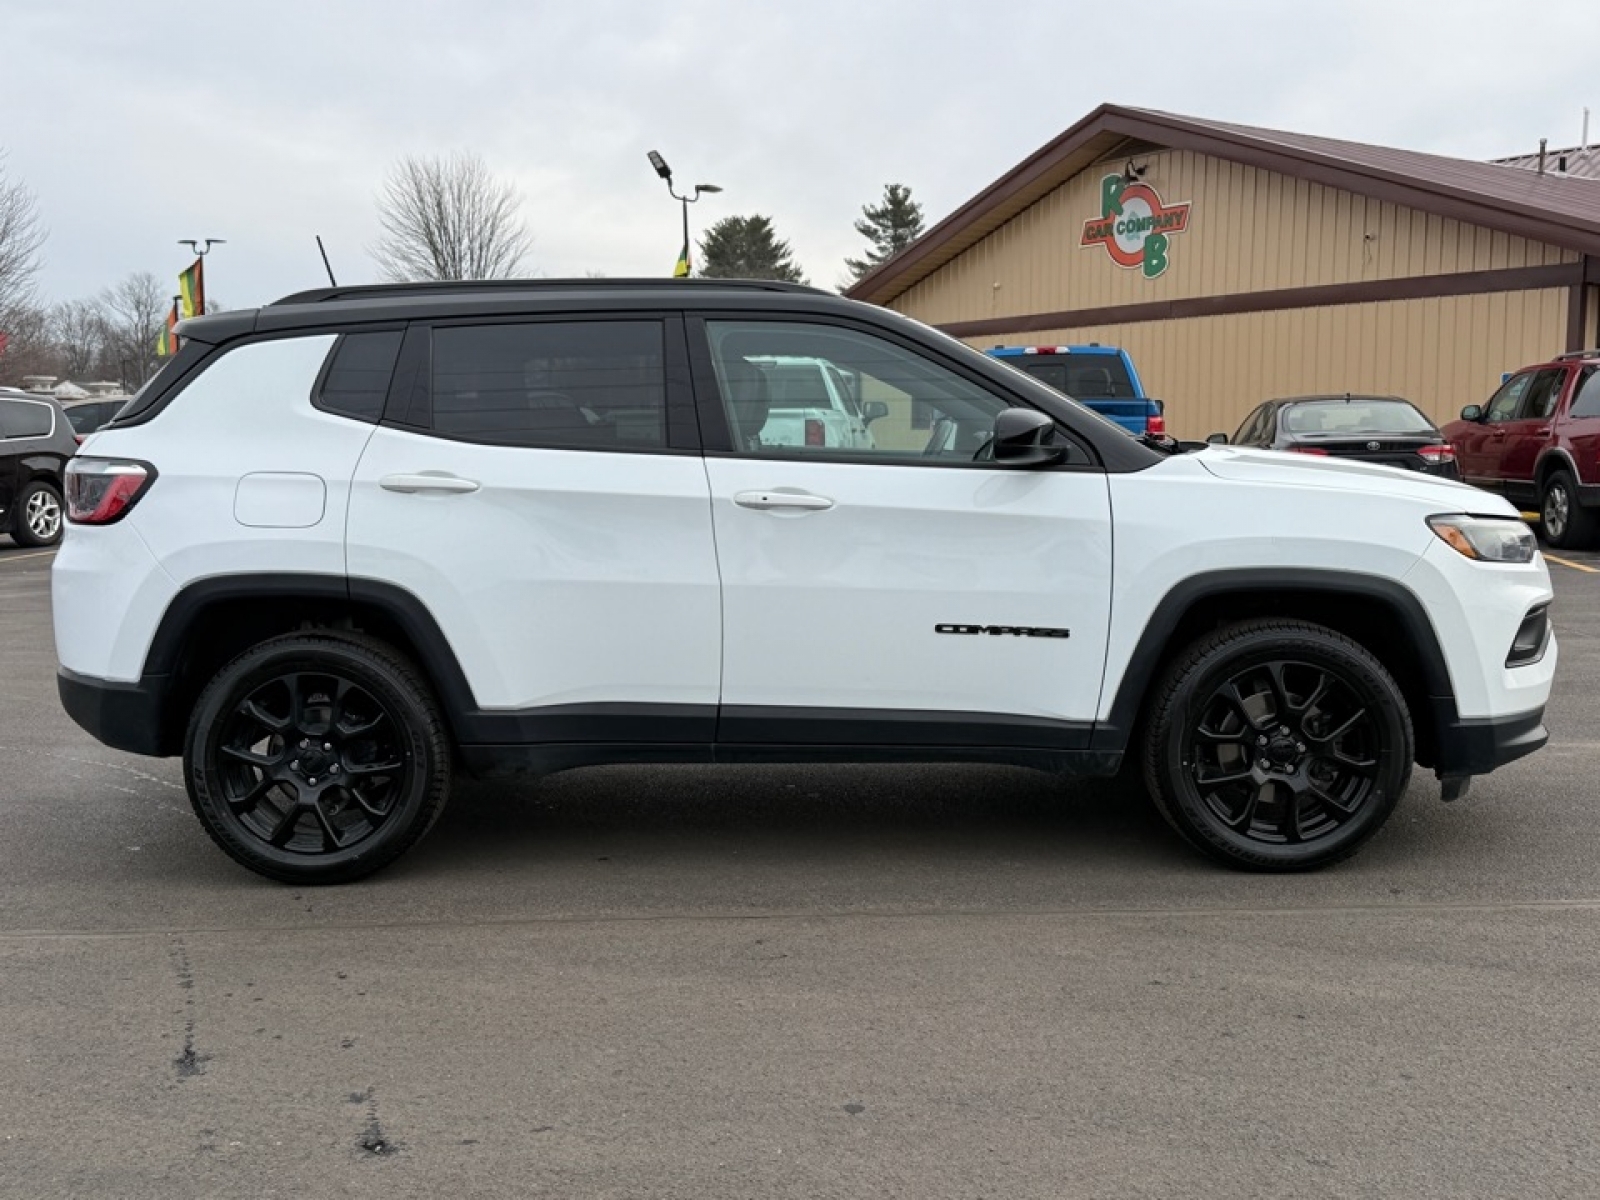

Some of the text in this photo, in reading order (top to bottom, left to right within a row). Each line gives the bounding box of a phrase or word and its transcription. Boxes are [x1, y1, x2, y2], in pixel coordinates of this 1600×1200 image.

[1086, 222, 1114, 240] CAR
[1116, 210, 1185, 236] COMPANY
[1142, 233, 1168, 277] B
[935, 624, 1070, 638] COMPASS
